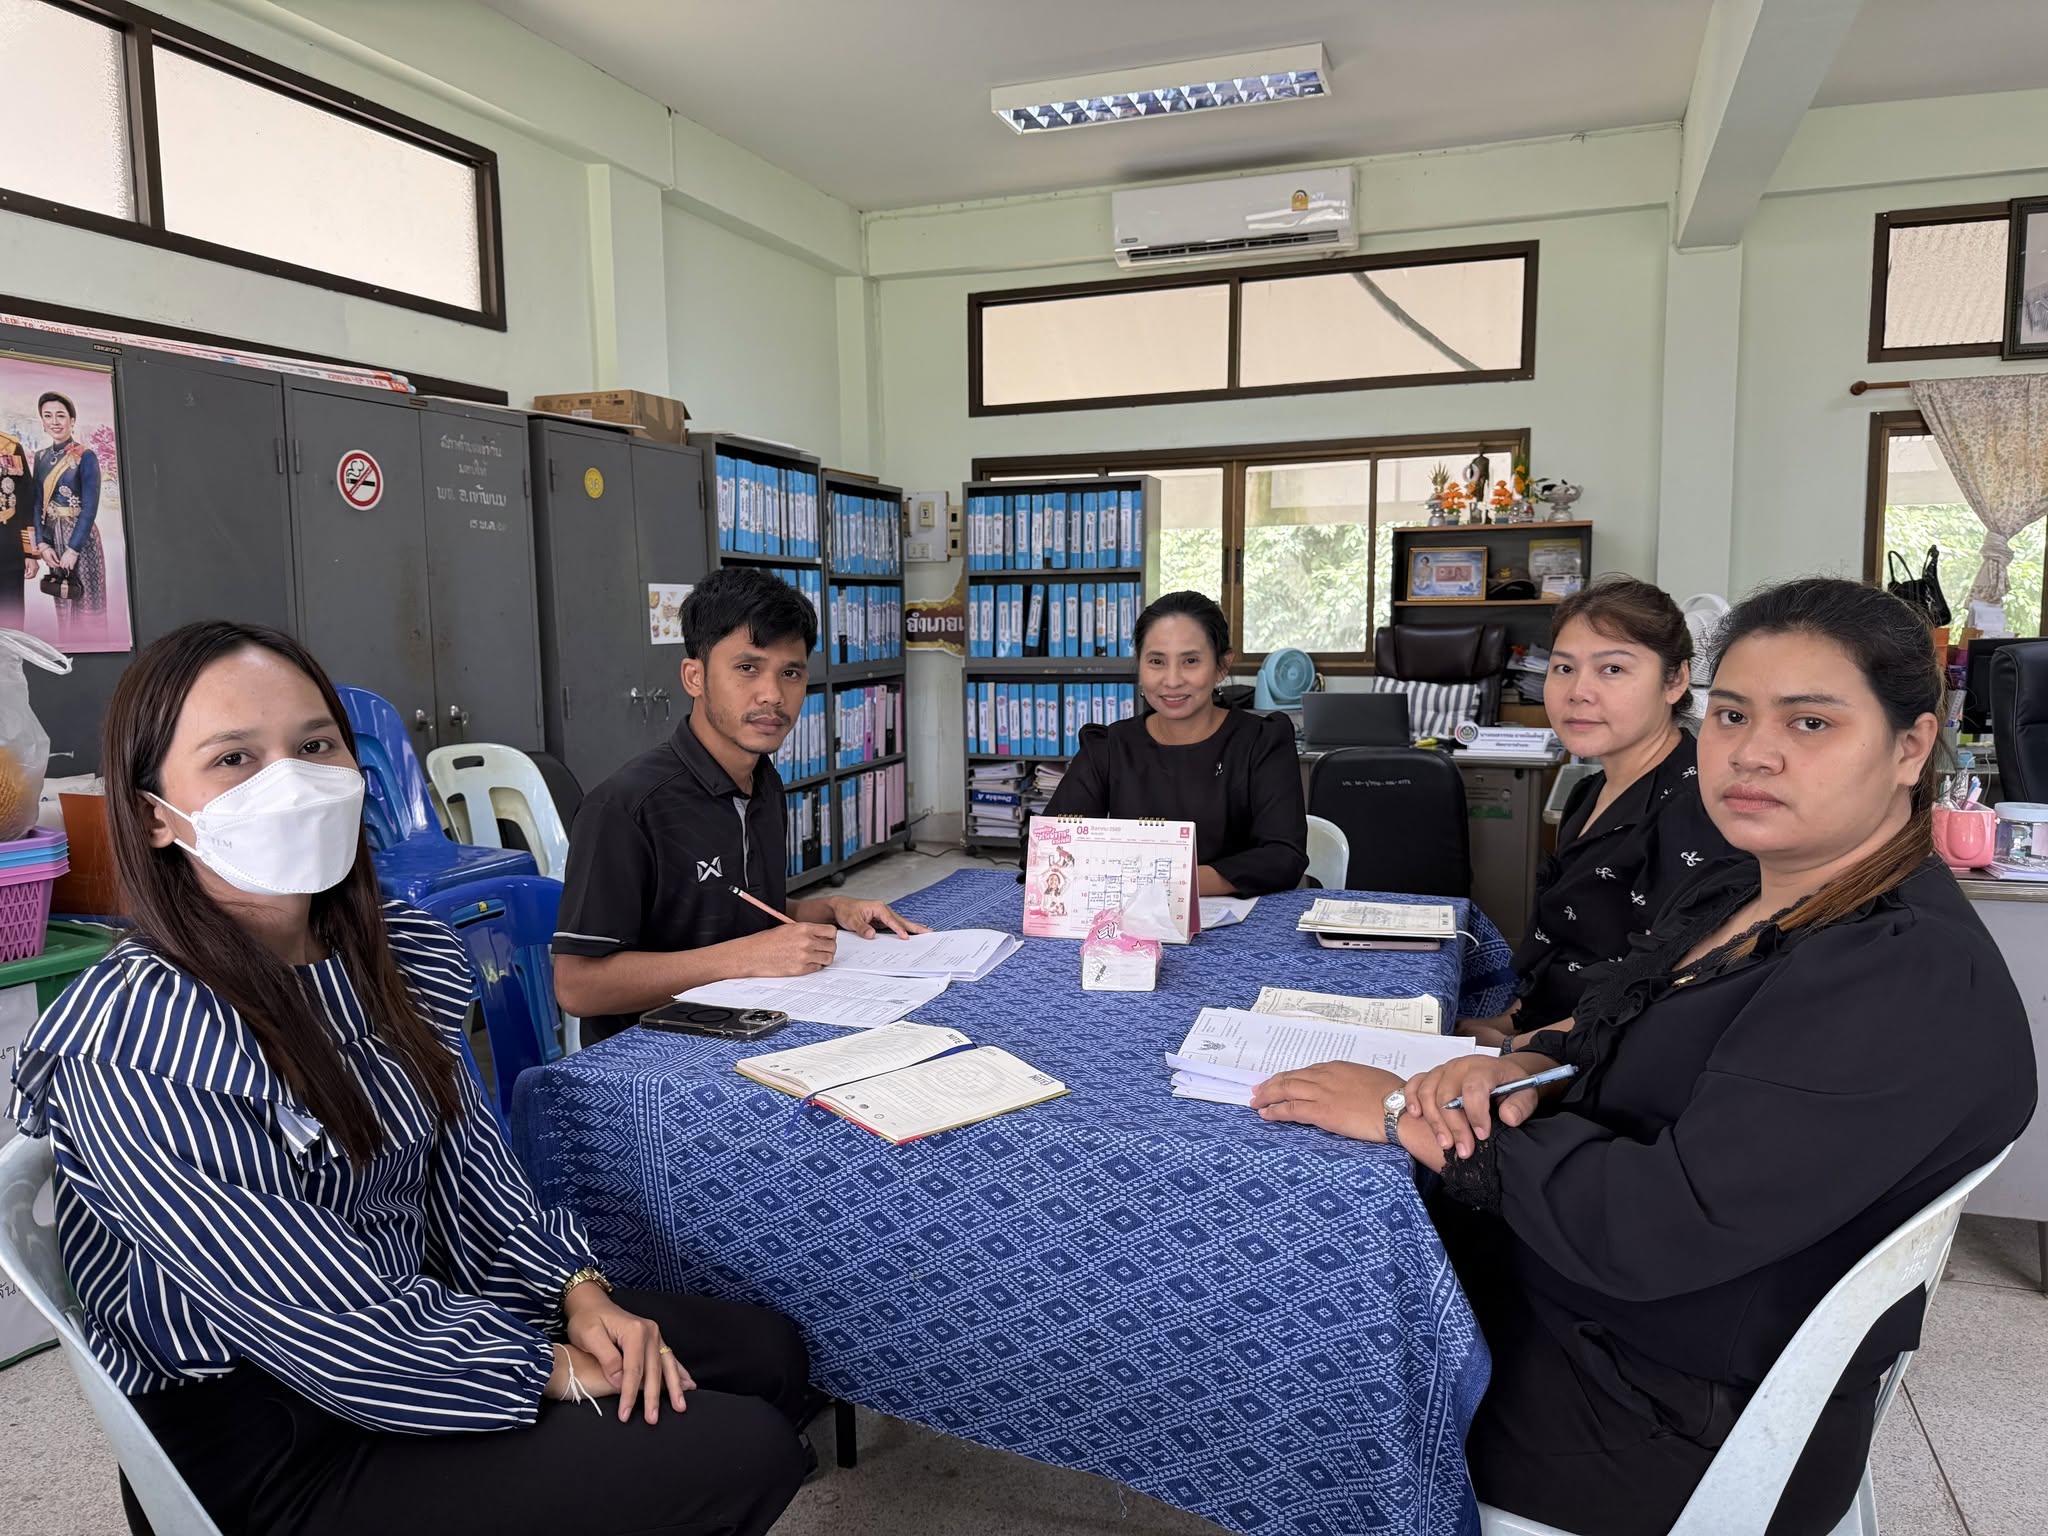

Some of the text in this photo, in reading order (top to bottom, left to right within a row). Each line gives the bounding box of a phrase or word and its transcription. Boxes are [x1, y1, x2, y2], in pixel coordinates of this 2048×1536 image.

[977, 793, 1013, 803] Double A
[1076, 825, 1089, 835] 08
